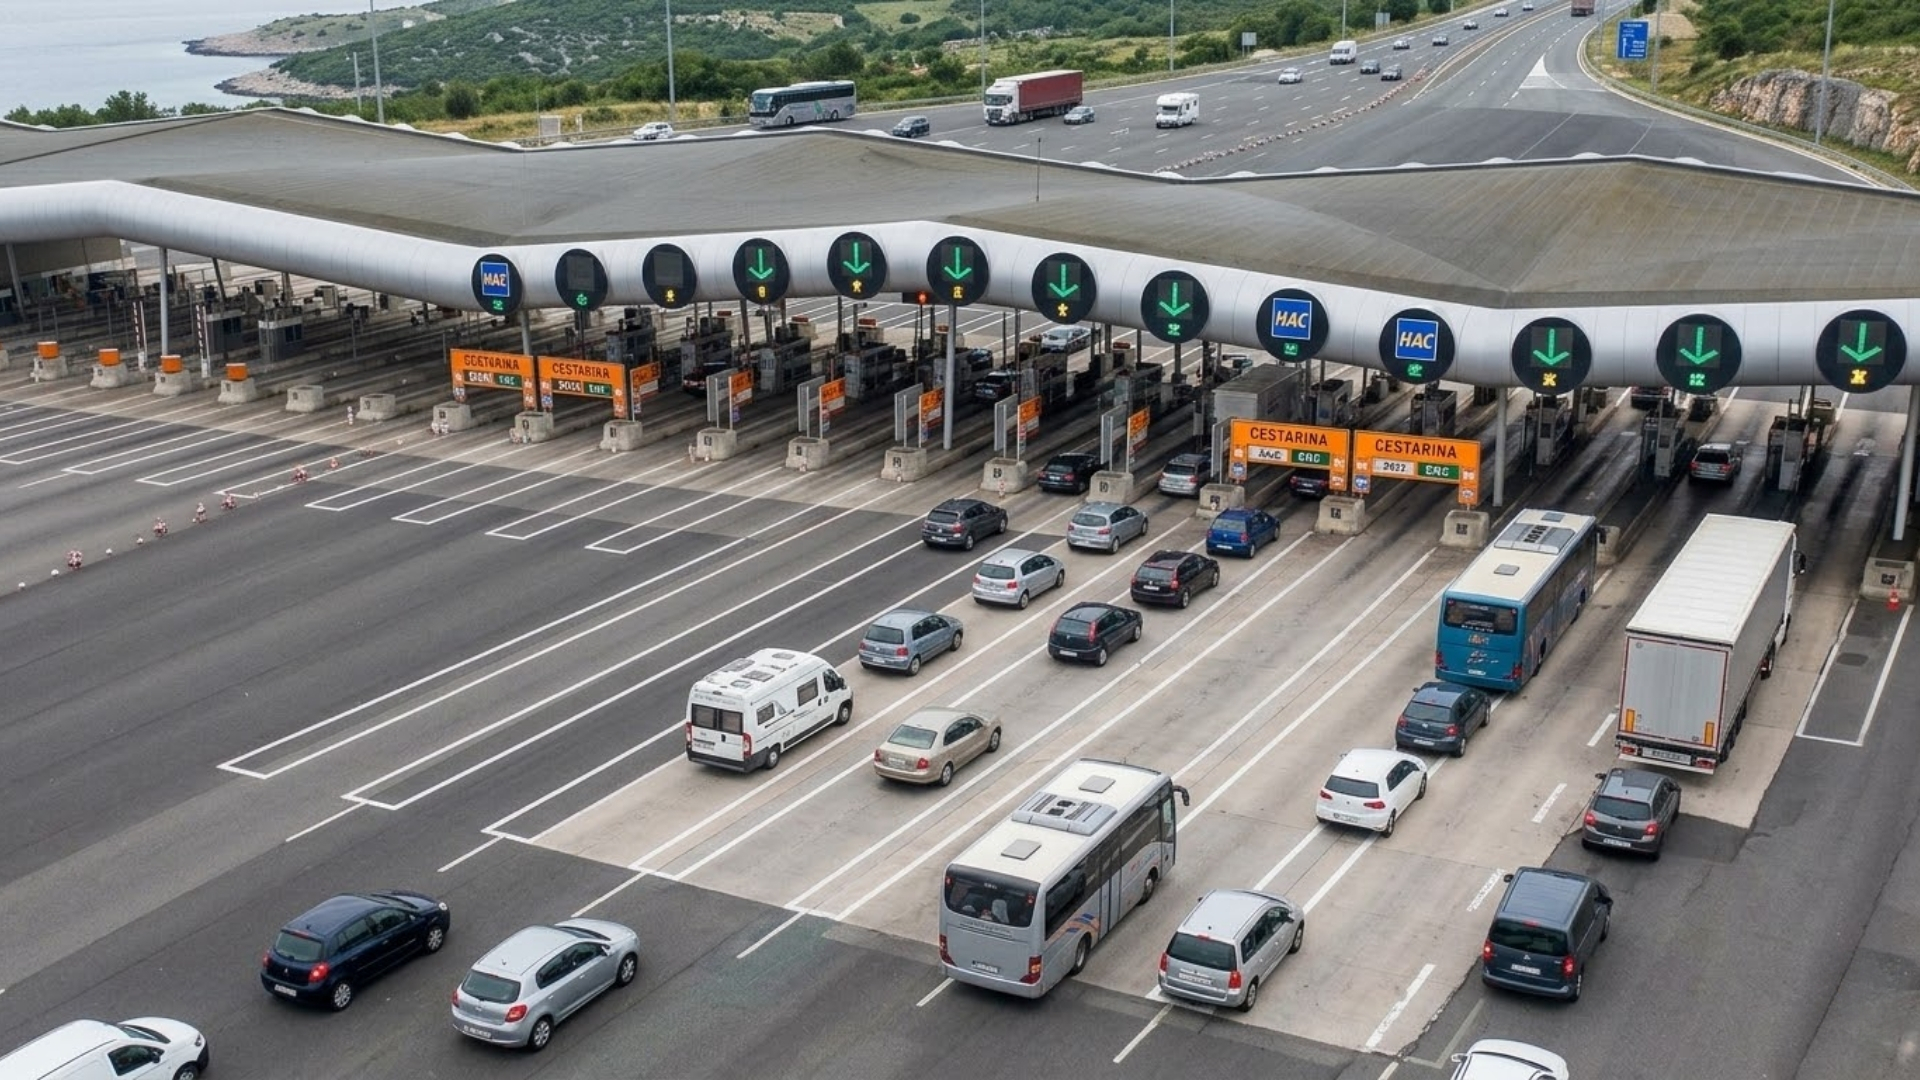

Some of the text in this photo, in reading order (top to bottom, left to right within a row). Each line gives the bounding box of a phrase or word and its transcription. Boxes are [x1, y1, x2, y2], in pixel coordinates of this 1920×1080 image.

[1275, 310, 1309, 328] HAC
[1400, 331, 1435, 349] HAC
[1250, 427, 1328, 446] CESTARINA
[1375, 438, 1457, 459] CESTARINA
